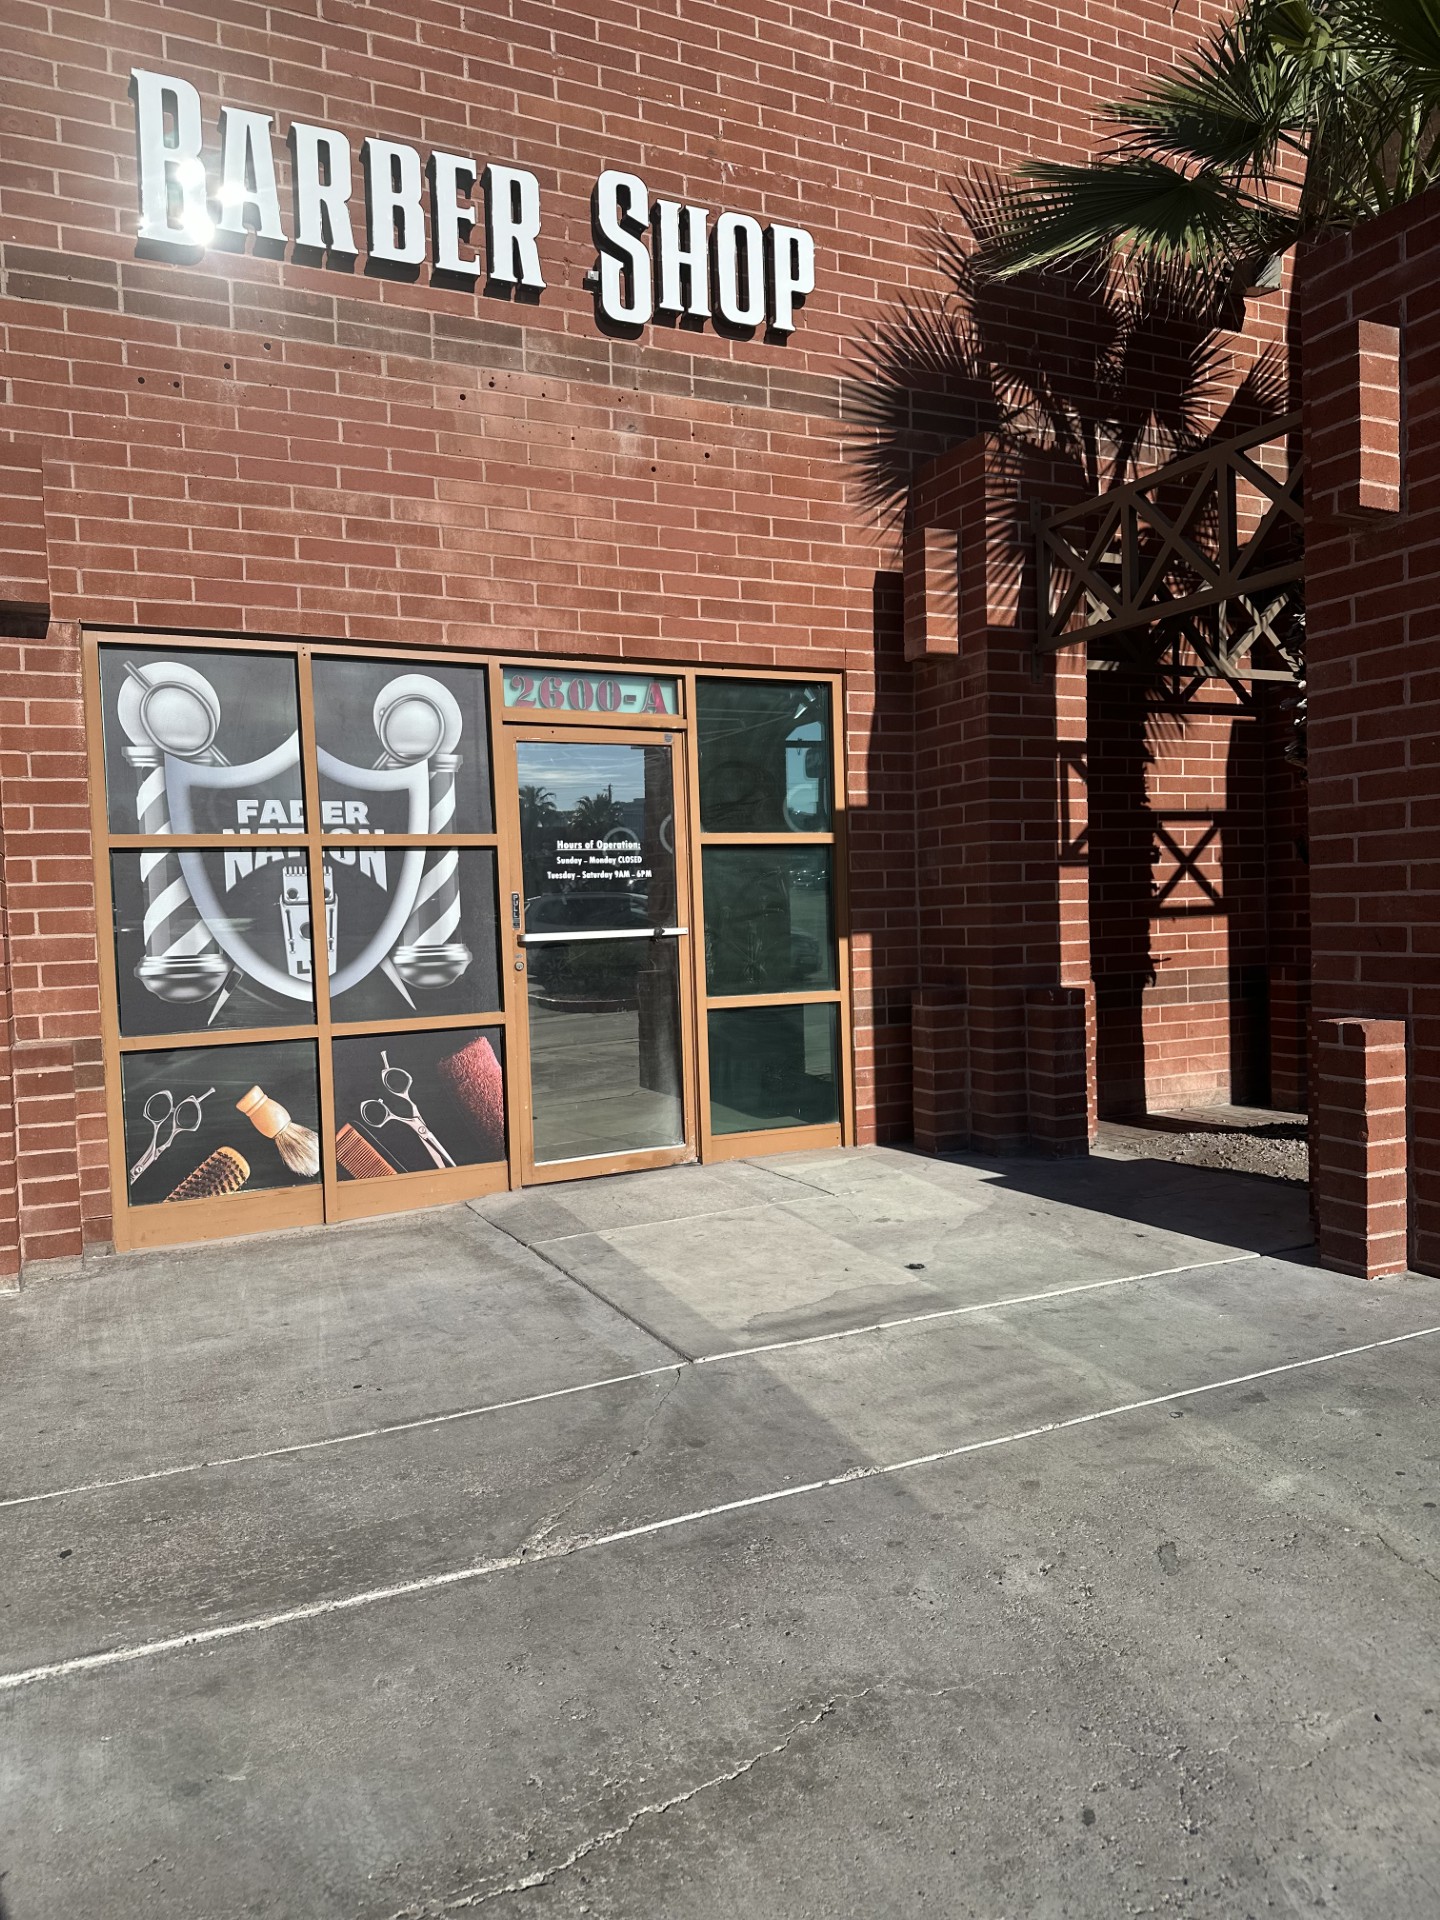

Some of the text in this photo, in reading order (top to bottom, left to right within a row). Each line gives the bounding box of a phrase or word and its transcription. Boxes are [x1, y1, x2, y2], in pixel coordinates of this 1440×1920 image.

[596, 168, 815, 333] SHOP
[510, 674, 668, 715] 2600-A
[556, 839, 642, 850] Hours of Operation:
[556, 856, 582, 865] Sunday
[589, 856, 617, 865] Monday
[618, 855, 642, 864] CLOSED
[547, 871, 576, 880] Tuesday
[582, 870, 613, 880] Saturday
[614, 870, 630, 878] 9AM
[636, 869, 652, 878] 6PM
